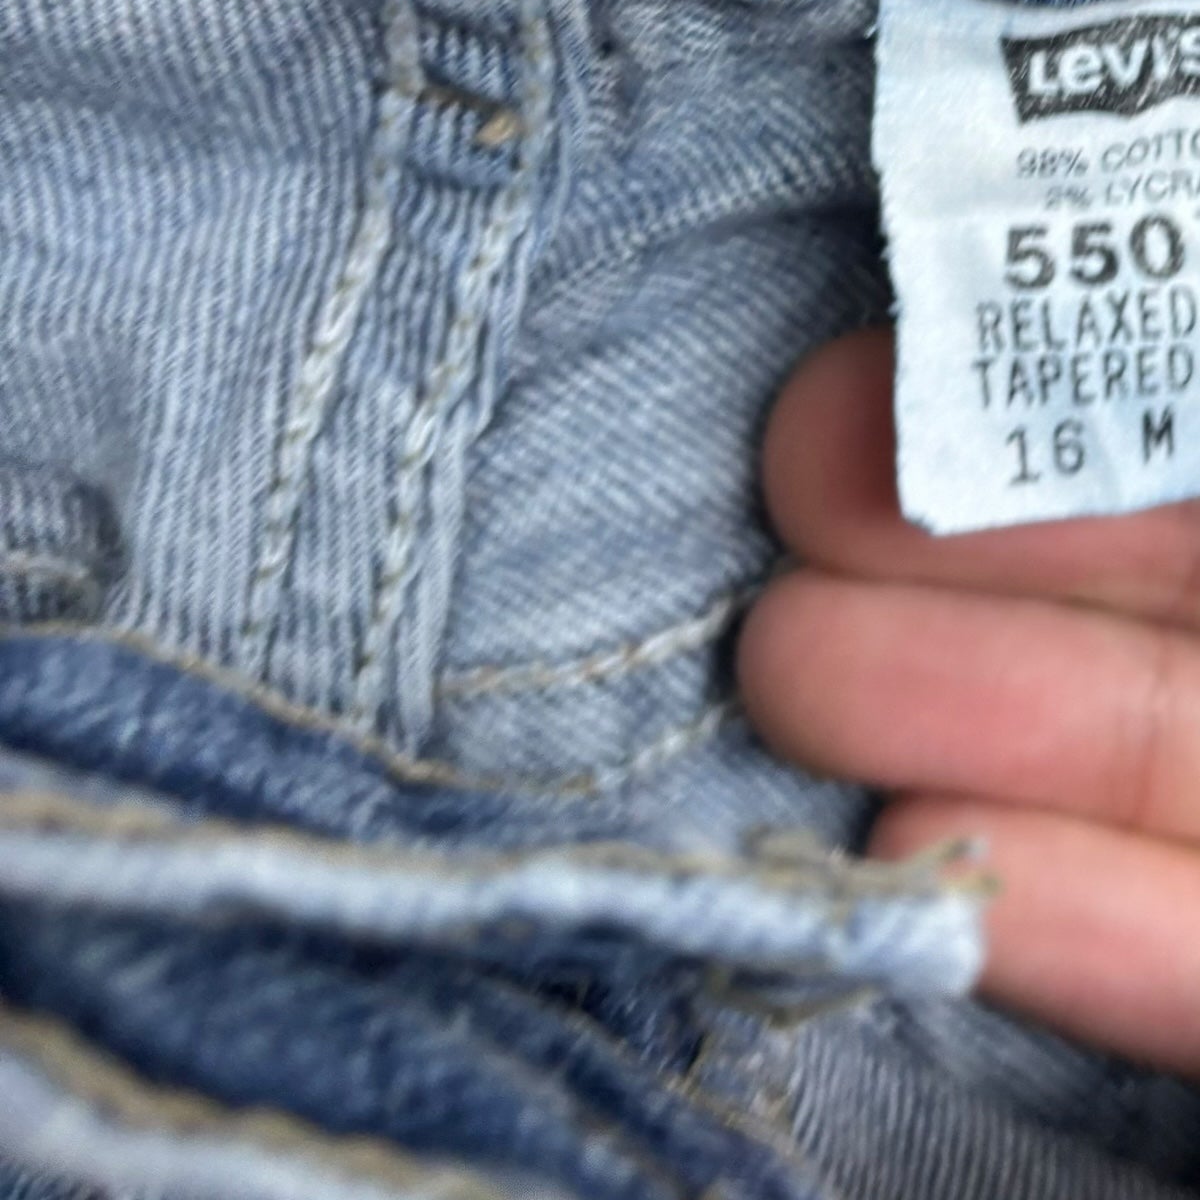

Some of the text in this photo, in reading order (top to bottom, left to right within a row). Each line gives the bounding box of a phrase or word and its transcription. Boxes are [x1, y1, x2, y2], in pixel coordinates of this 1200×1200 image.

[977, 286, 1197, 352] RELAXED
[972, 349, 1195, 407] TAPERED
[1005, 407, 1175, 484] 16 M
